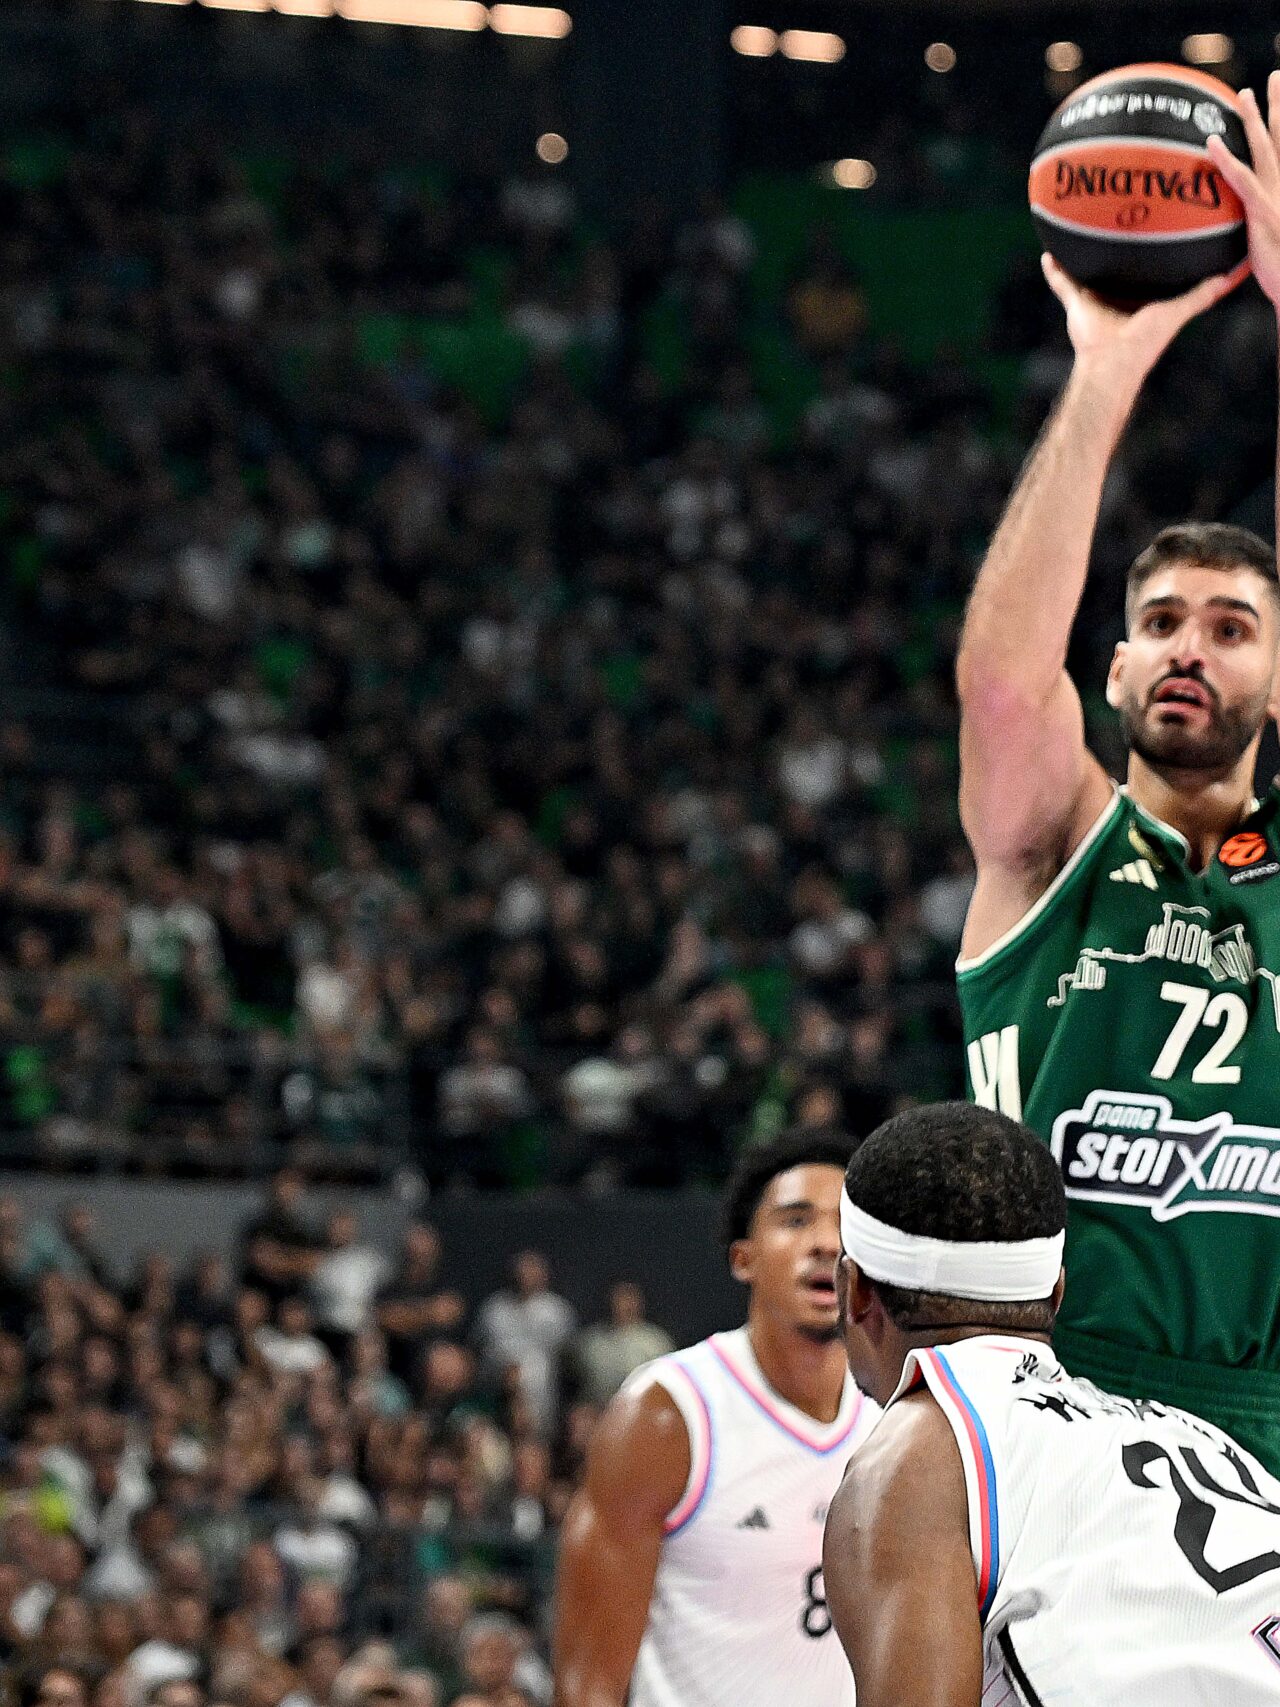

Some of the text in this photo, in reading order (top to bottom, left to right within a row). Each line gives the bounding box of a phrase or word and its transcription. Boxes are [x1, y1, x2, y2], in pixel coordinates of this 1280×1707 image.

[1056, 159, 1221, 209] SPALDING
[1151, 981, 1249, 1084] 72
[803, 1566, 832, 1638] 8
